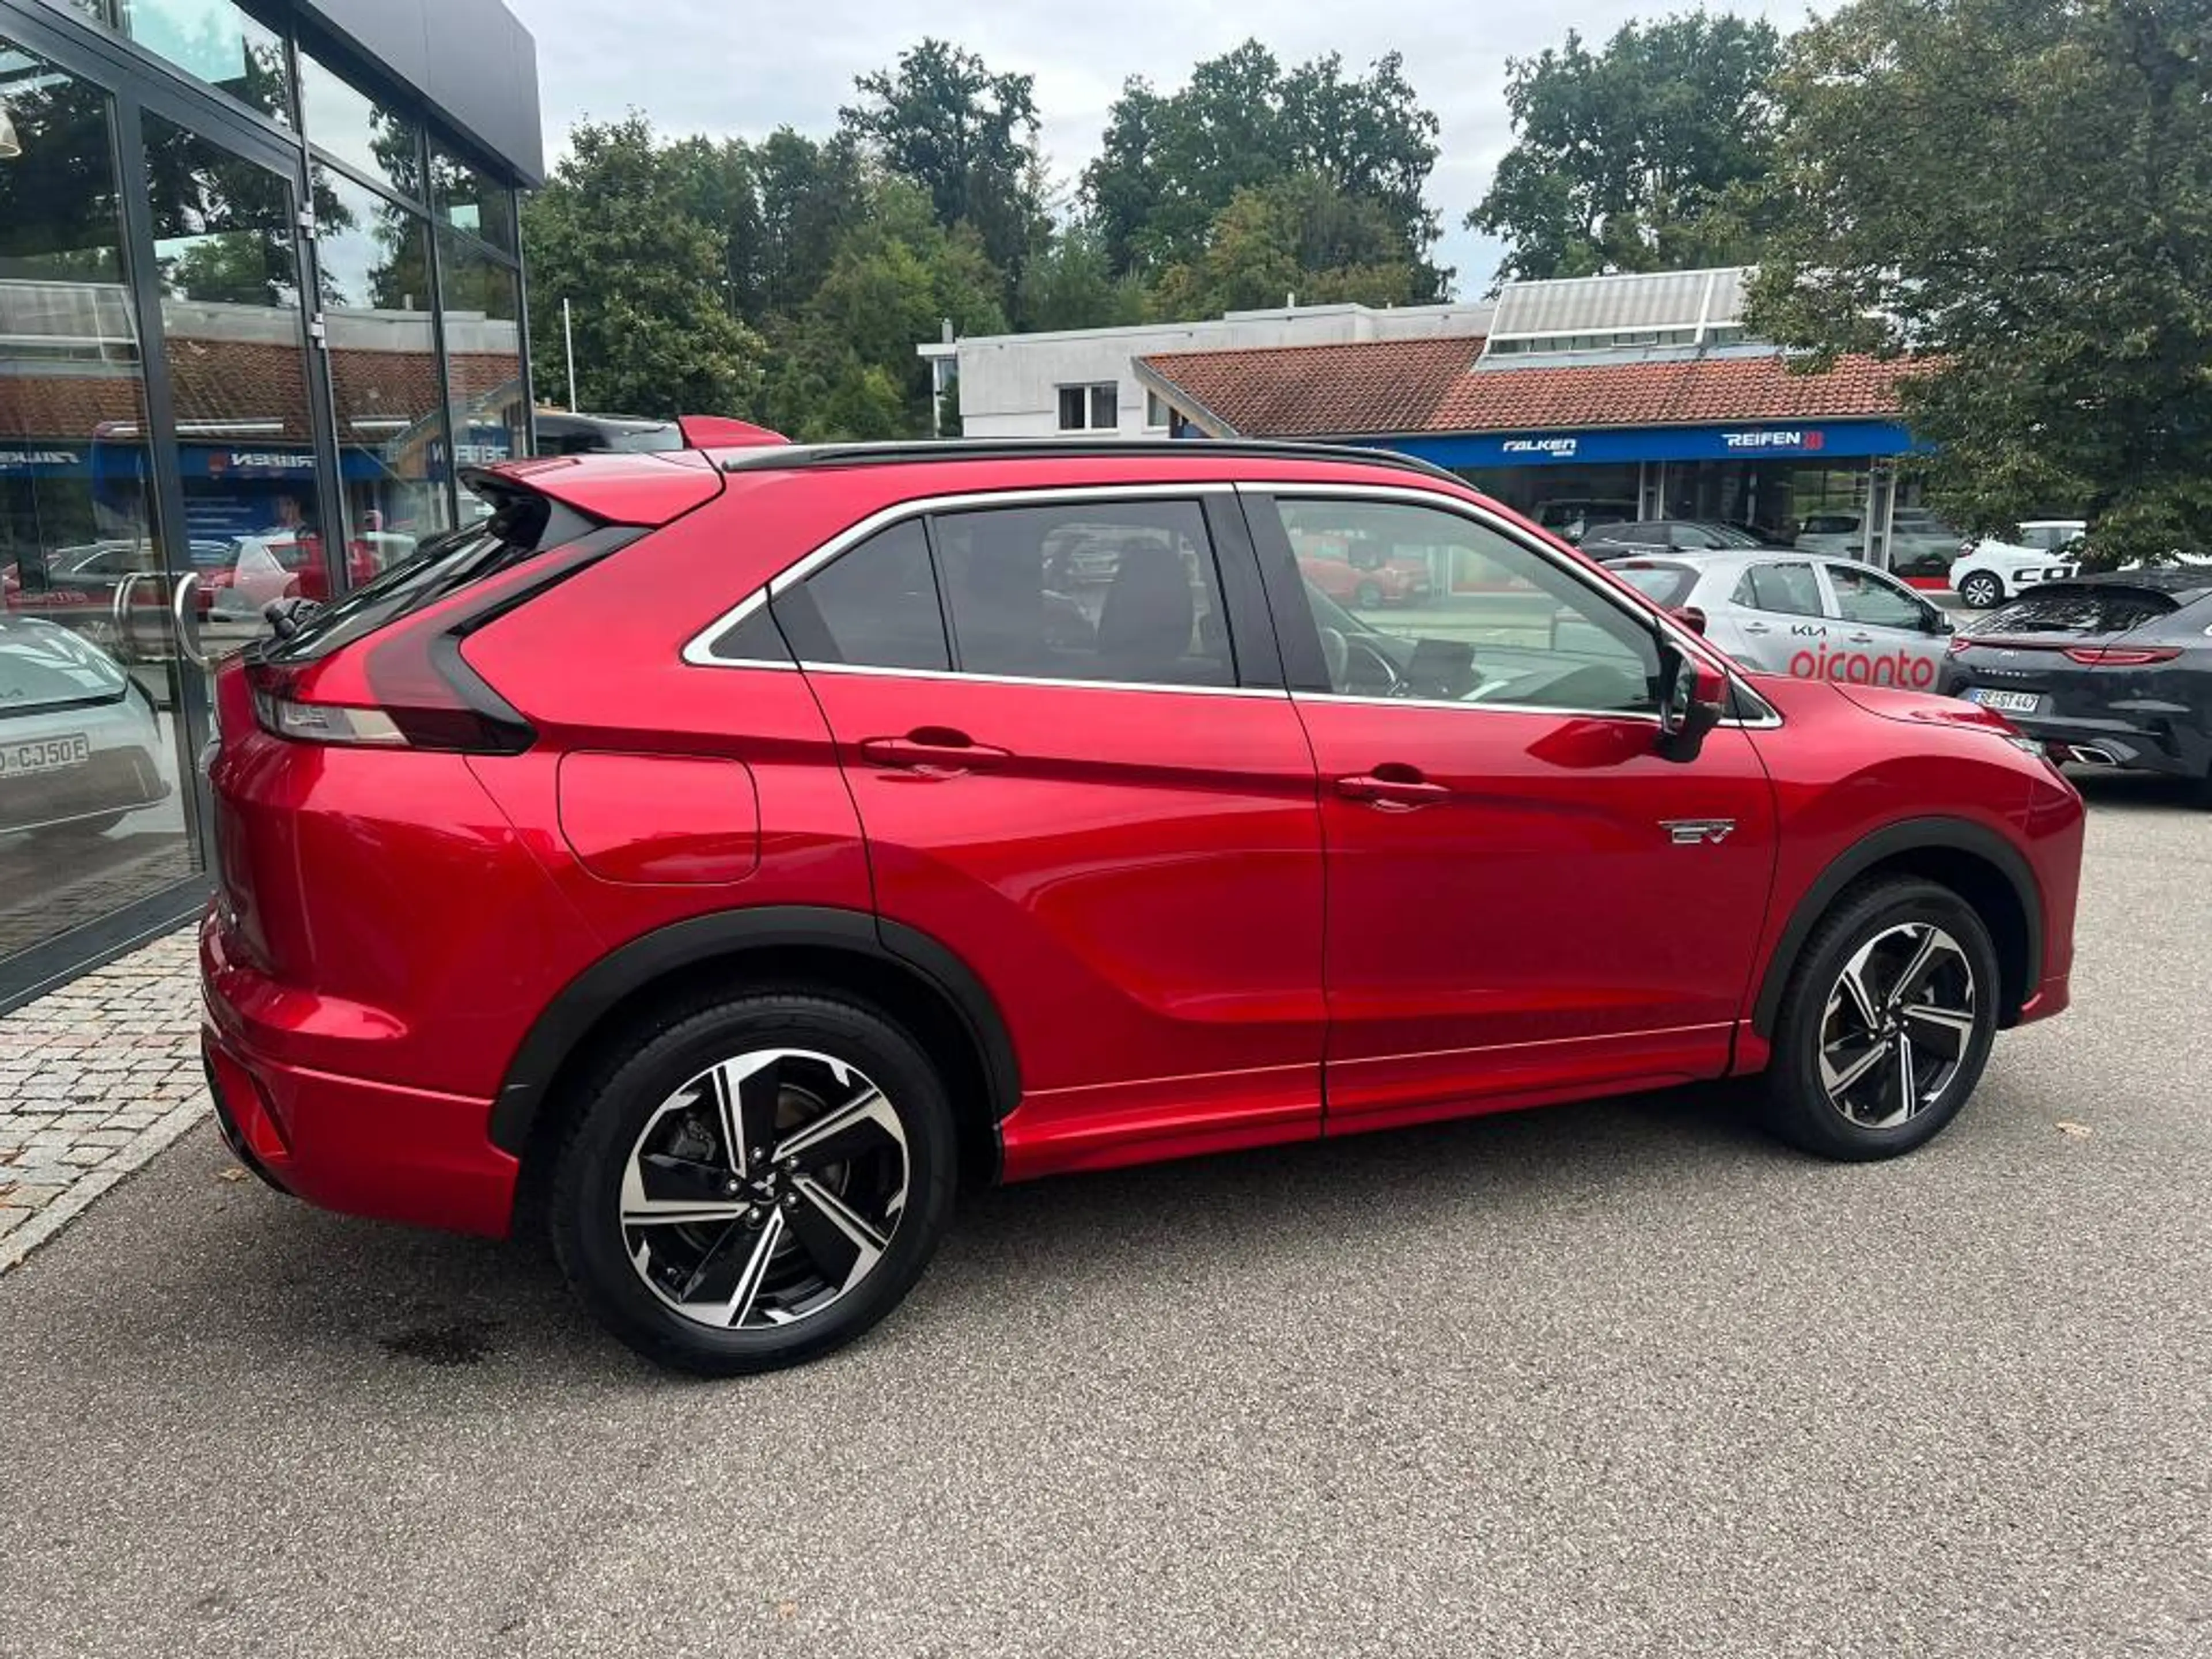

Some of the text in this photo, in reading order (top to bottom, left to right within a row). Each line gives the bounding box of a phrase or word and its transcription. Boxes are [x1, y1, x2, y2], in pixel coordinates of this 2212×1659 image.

[1721, 431, 1801, 446] REIFEN
[1503, 439, 1576, 452] FALKEN
[1791, 624, 1827, 636] KIA
